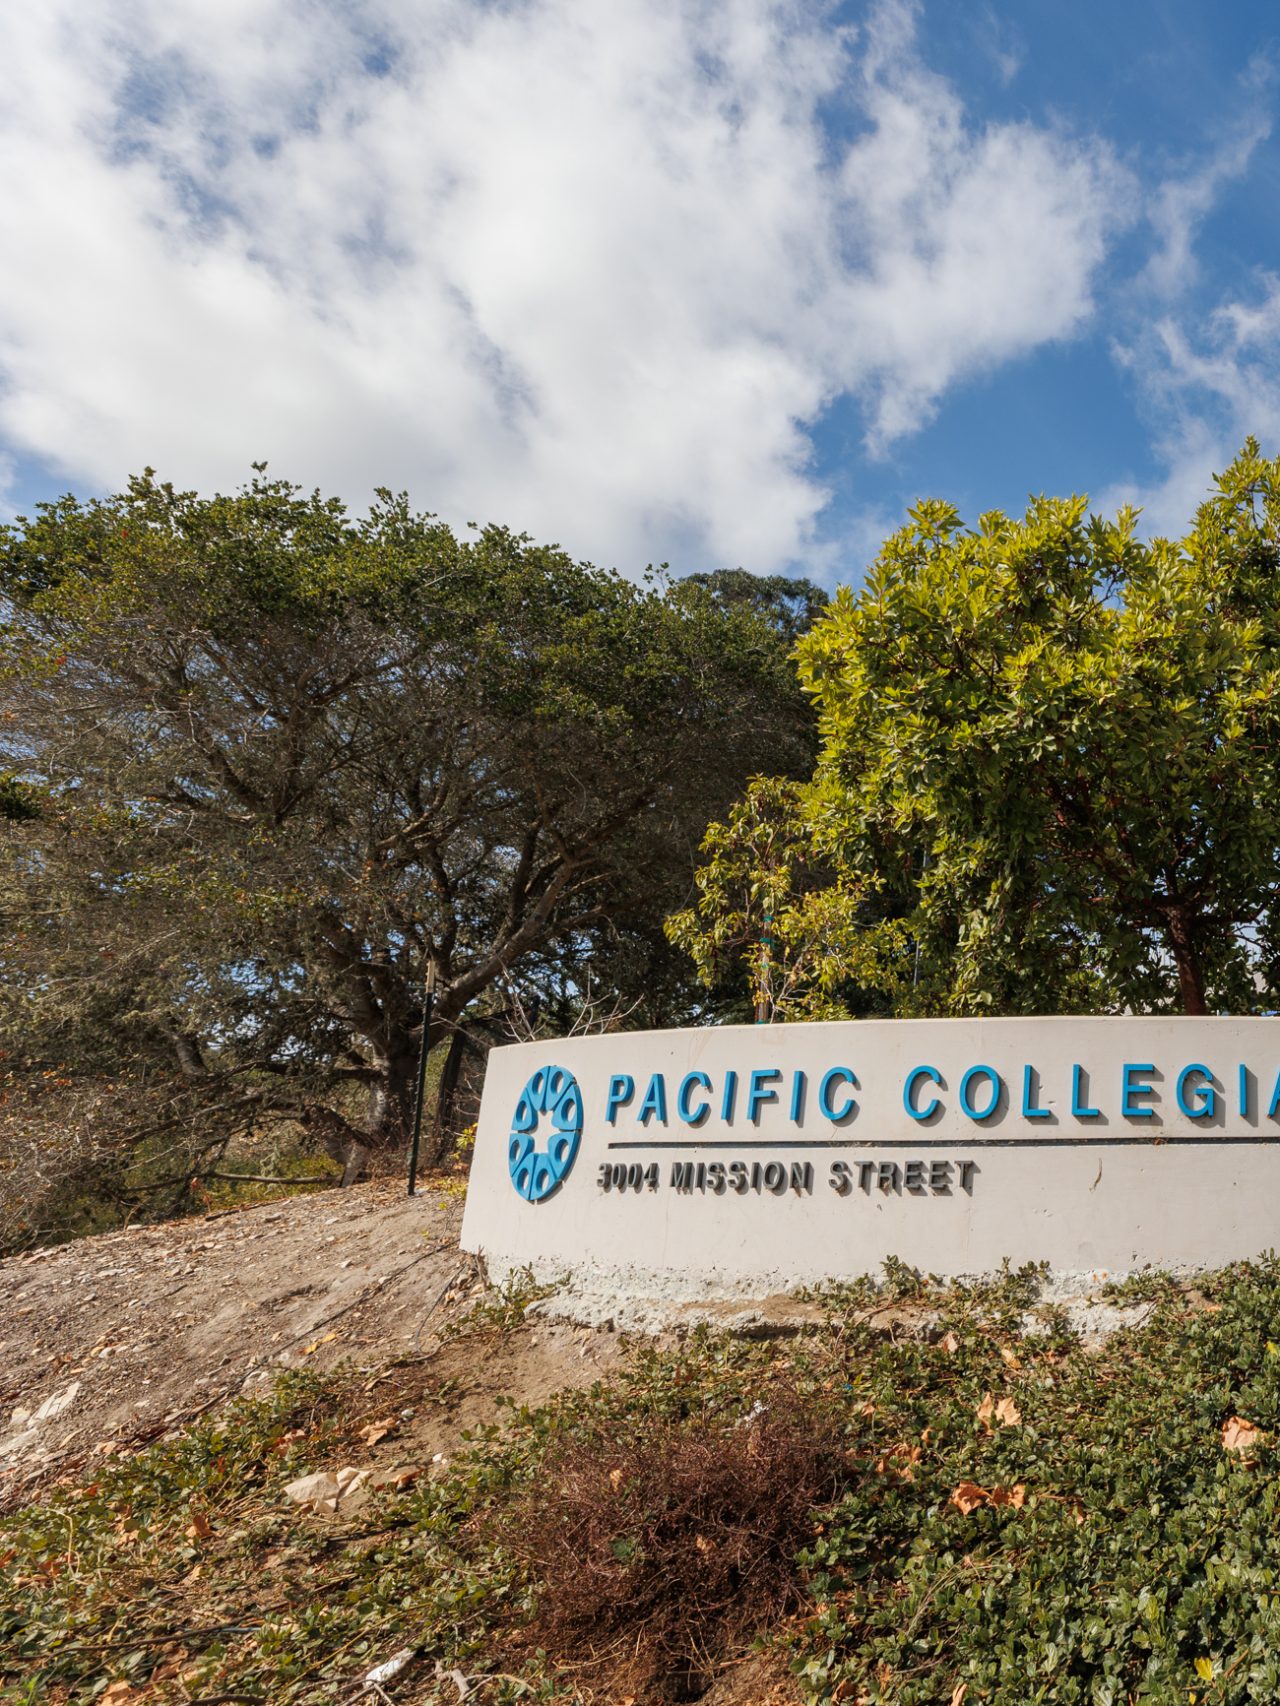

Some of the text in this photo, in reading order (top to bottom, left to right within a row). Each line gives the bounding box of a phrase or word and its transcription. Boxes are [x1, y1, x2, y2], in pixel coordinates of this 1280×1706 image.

[605, 1066, 858, 1124] PACIFIC
[597, 1160, 977, 1195] 3004 MISSION STREET
